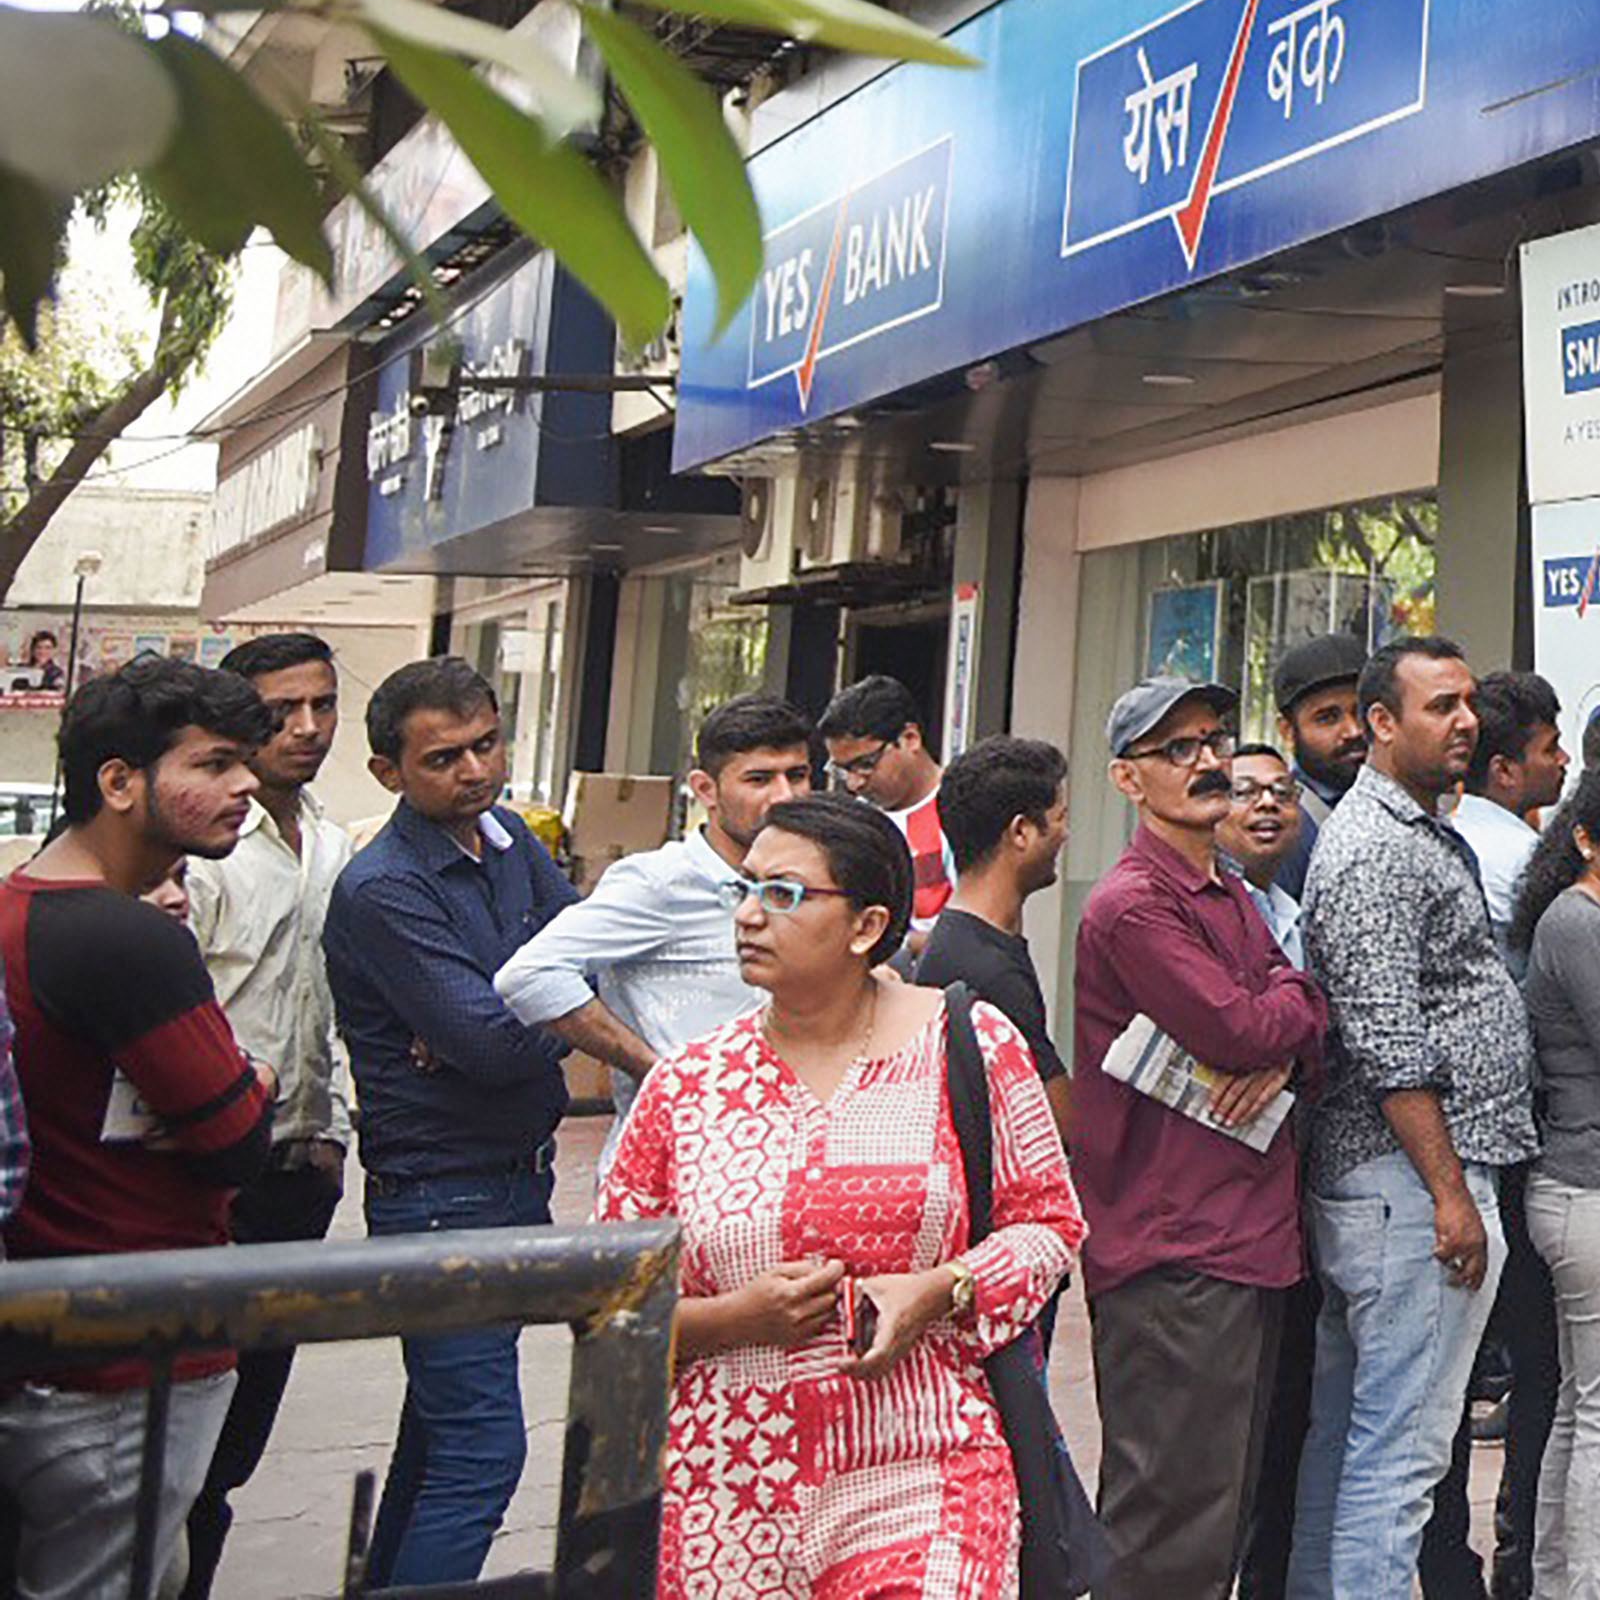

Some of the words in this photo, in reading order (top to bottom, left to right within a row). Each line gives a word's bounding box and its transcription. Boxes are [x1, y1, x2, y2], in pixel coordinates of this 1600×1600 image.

[1121, 47, 1198, 185] येस
[761, 250, 813, 343] YES
[842, 183, 932, 308] BANK
[1547, 569, 1579, 598] YES
